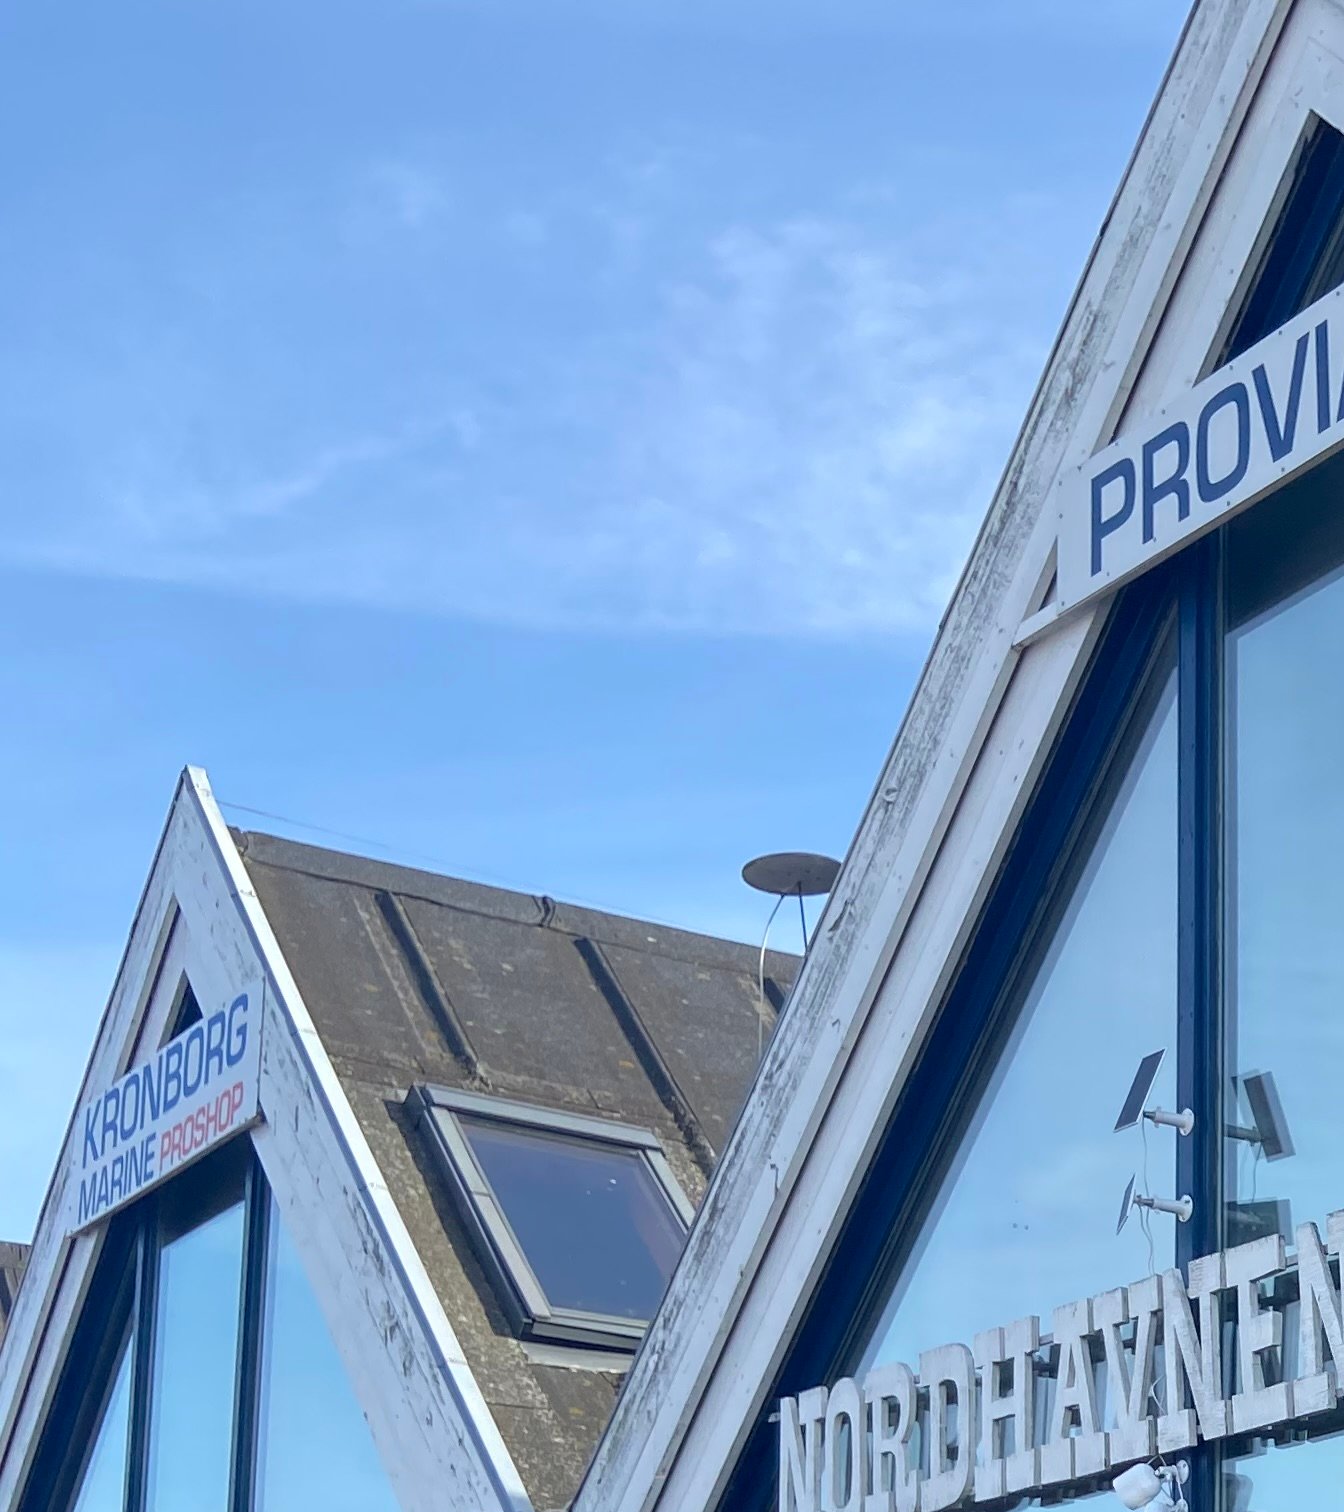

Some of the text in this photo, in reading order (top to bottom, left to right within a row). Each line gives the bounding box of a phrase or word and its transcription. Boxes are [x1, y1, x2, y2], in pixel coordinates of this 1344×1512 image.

[77, 1081, 244, 1225] MARINE PROSHOP
[82, 993, 248, 1170] KRONBORG
